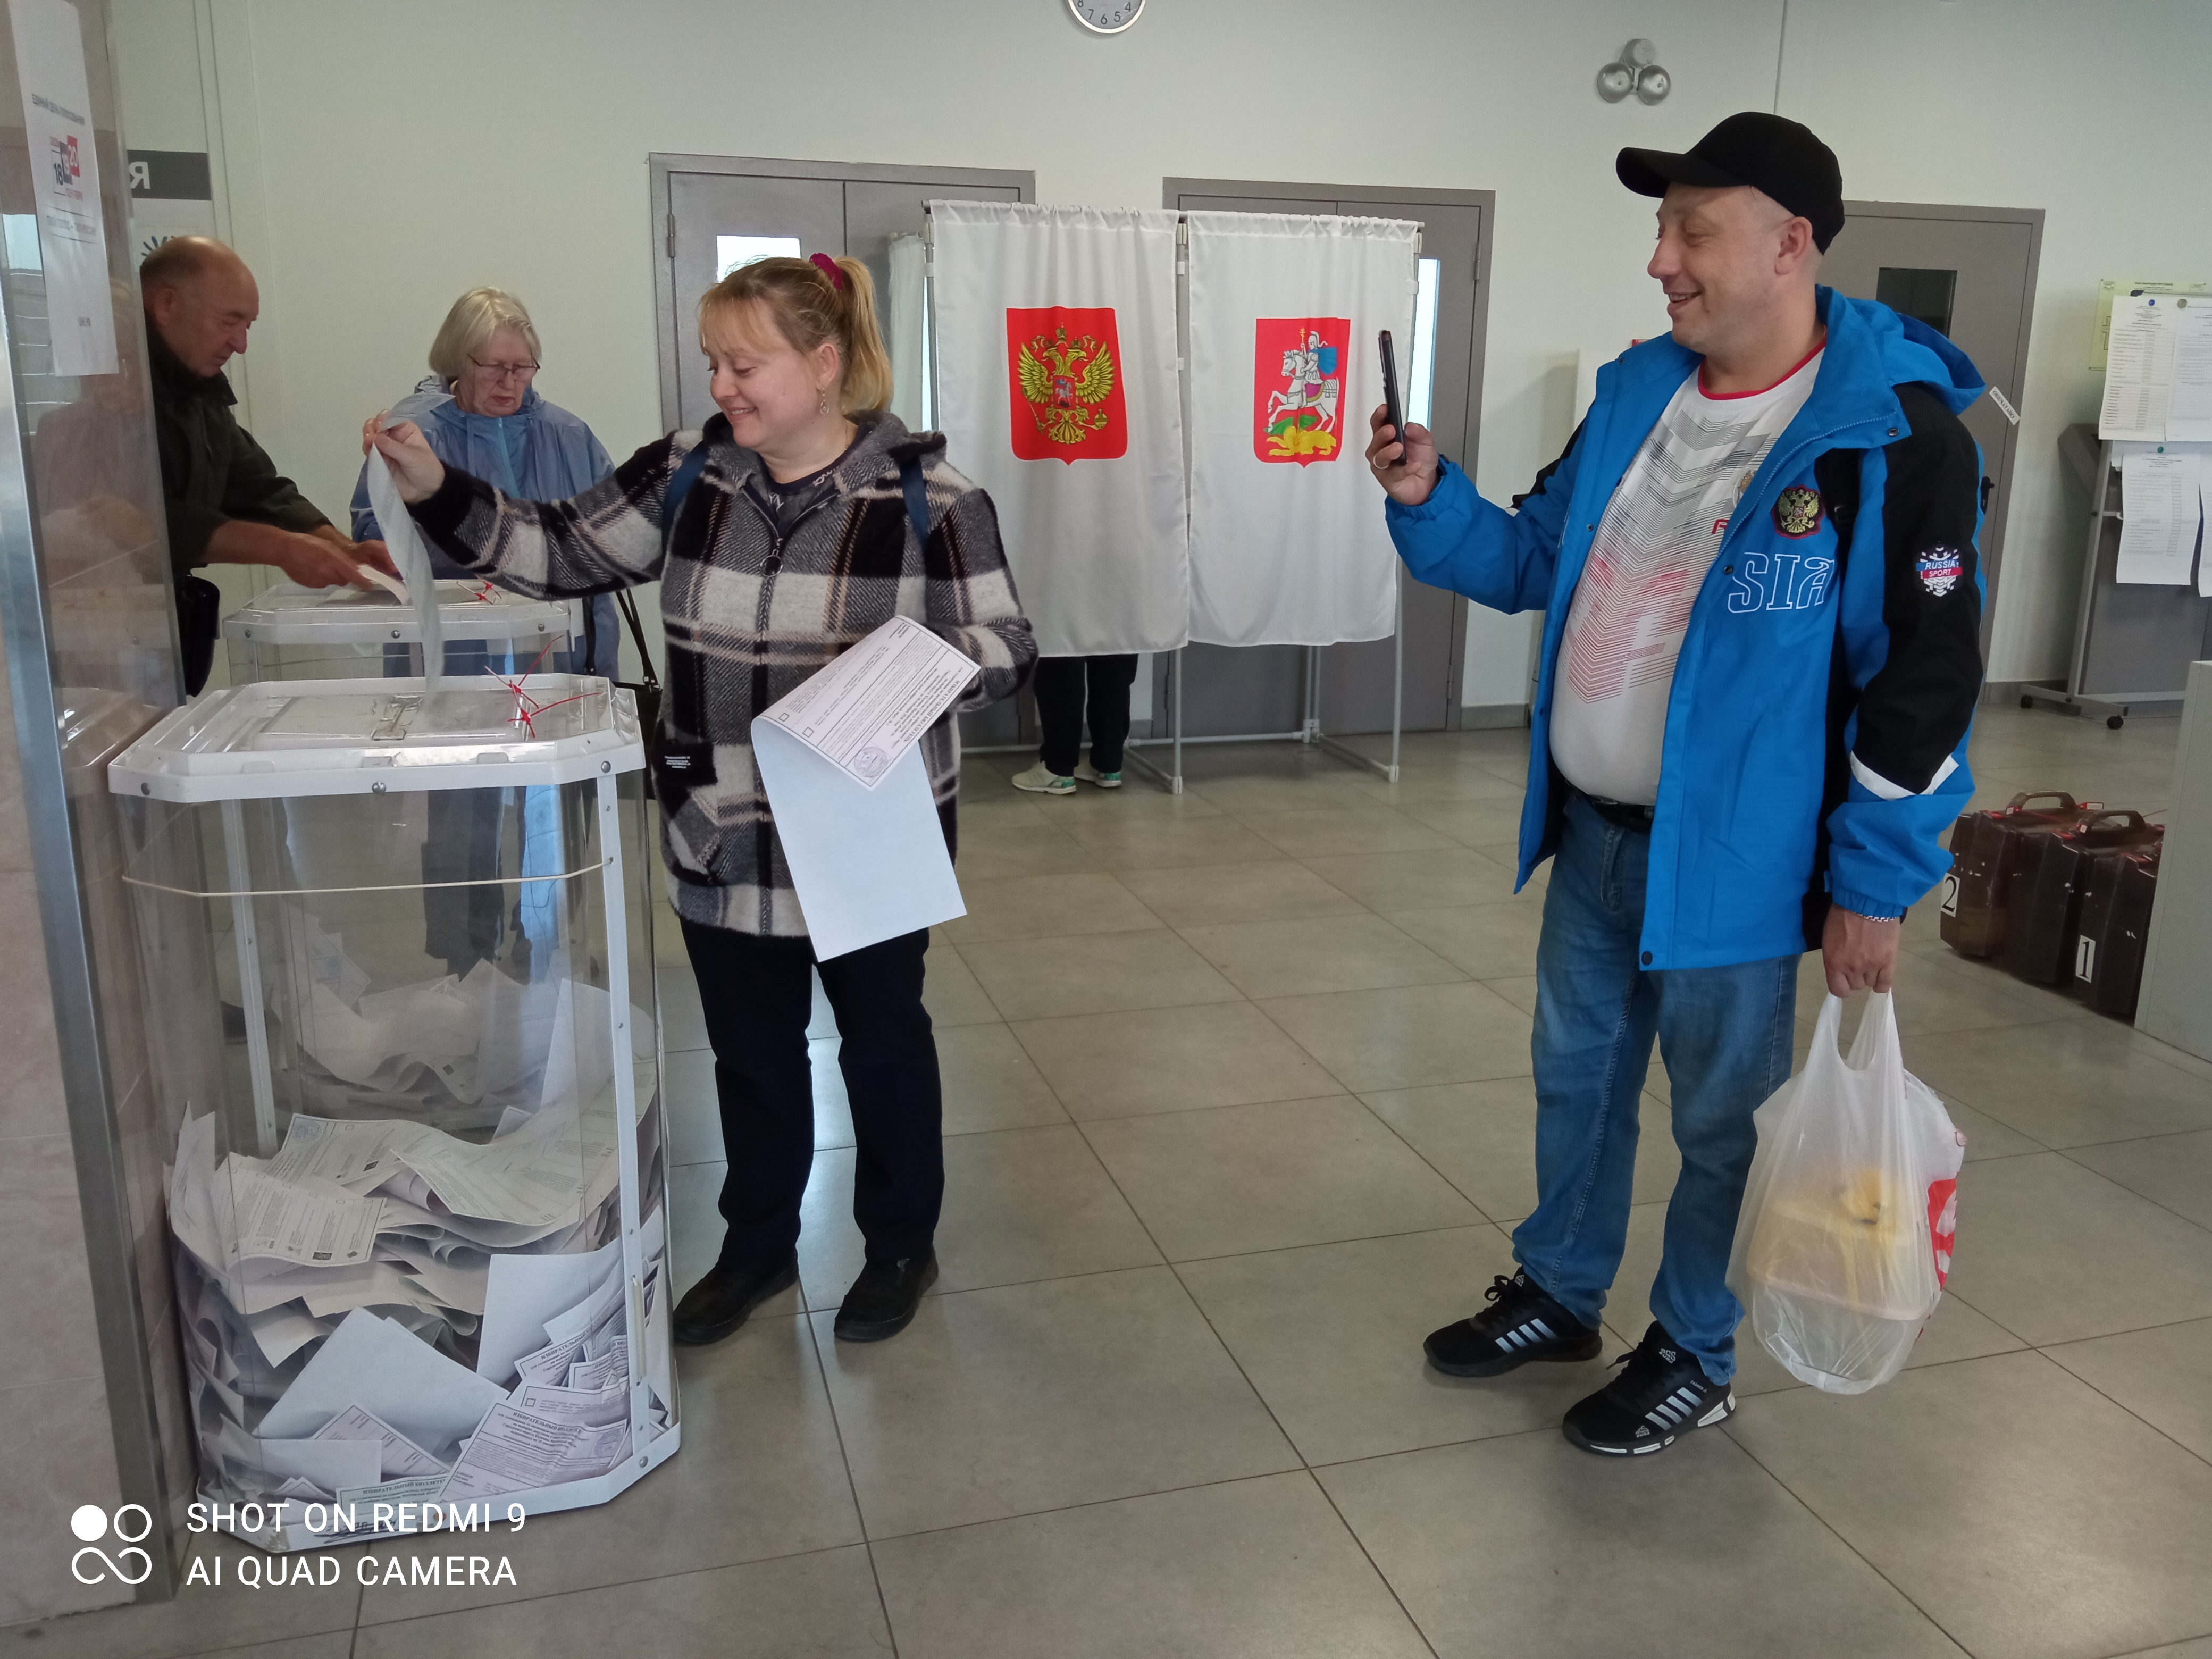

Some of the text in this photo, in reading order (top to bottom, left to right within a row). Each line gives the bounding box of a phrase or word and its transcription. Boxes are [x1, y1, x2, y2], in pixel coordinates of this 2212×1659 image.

[1125, 1, 1131, 12] 4
[1088, 9, 1094, 20] 7
[1100, 13, 1108, 24] 6
[1113, 11, 1120, 22] 5
[68, 144, 79, 168] 20
[54, 163, 64, 186] 18
[1925, 560, 1956, 571] RUSSIA
[1929, 568, 1952, 577] SPORT
[1941, 875, 1957, 913] 2
[2080, 940, 2090, 980] 1
